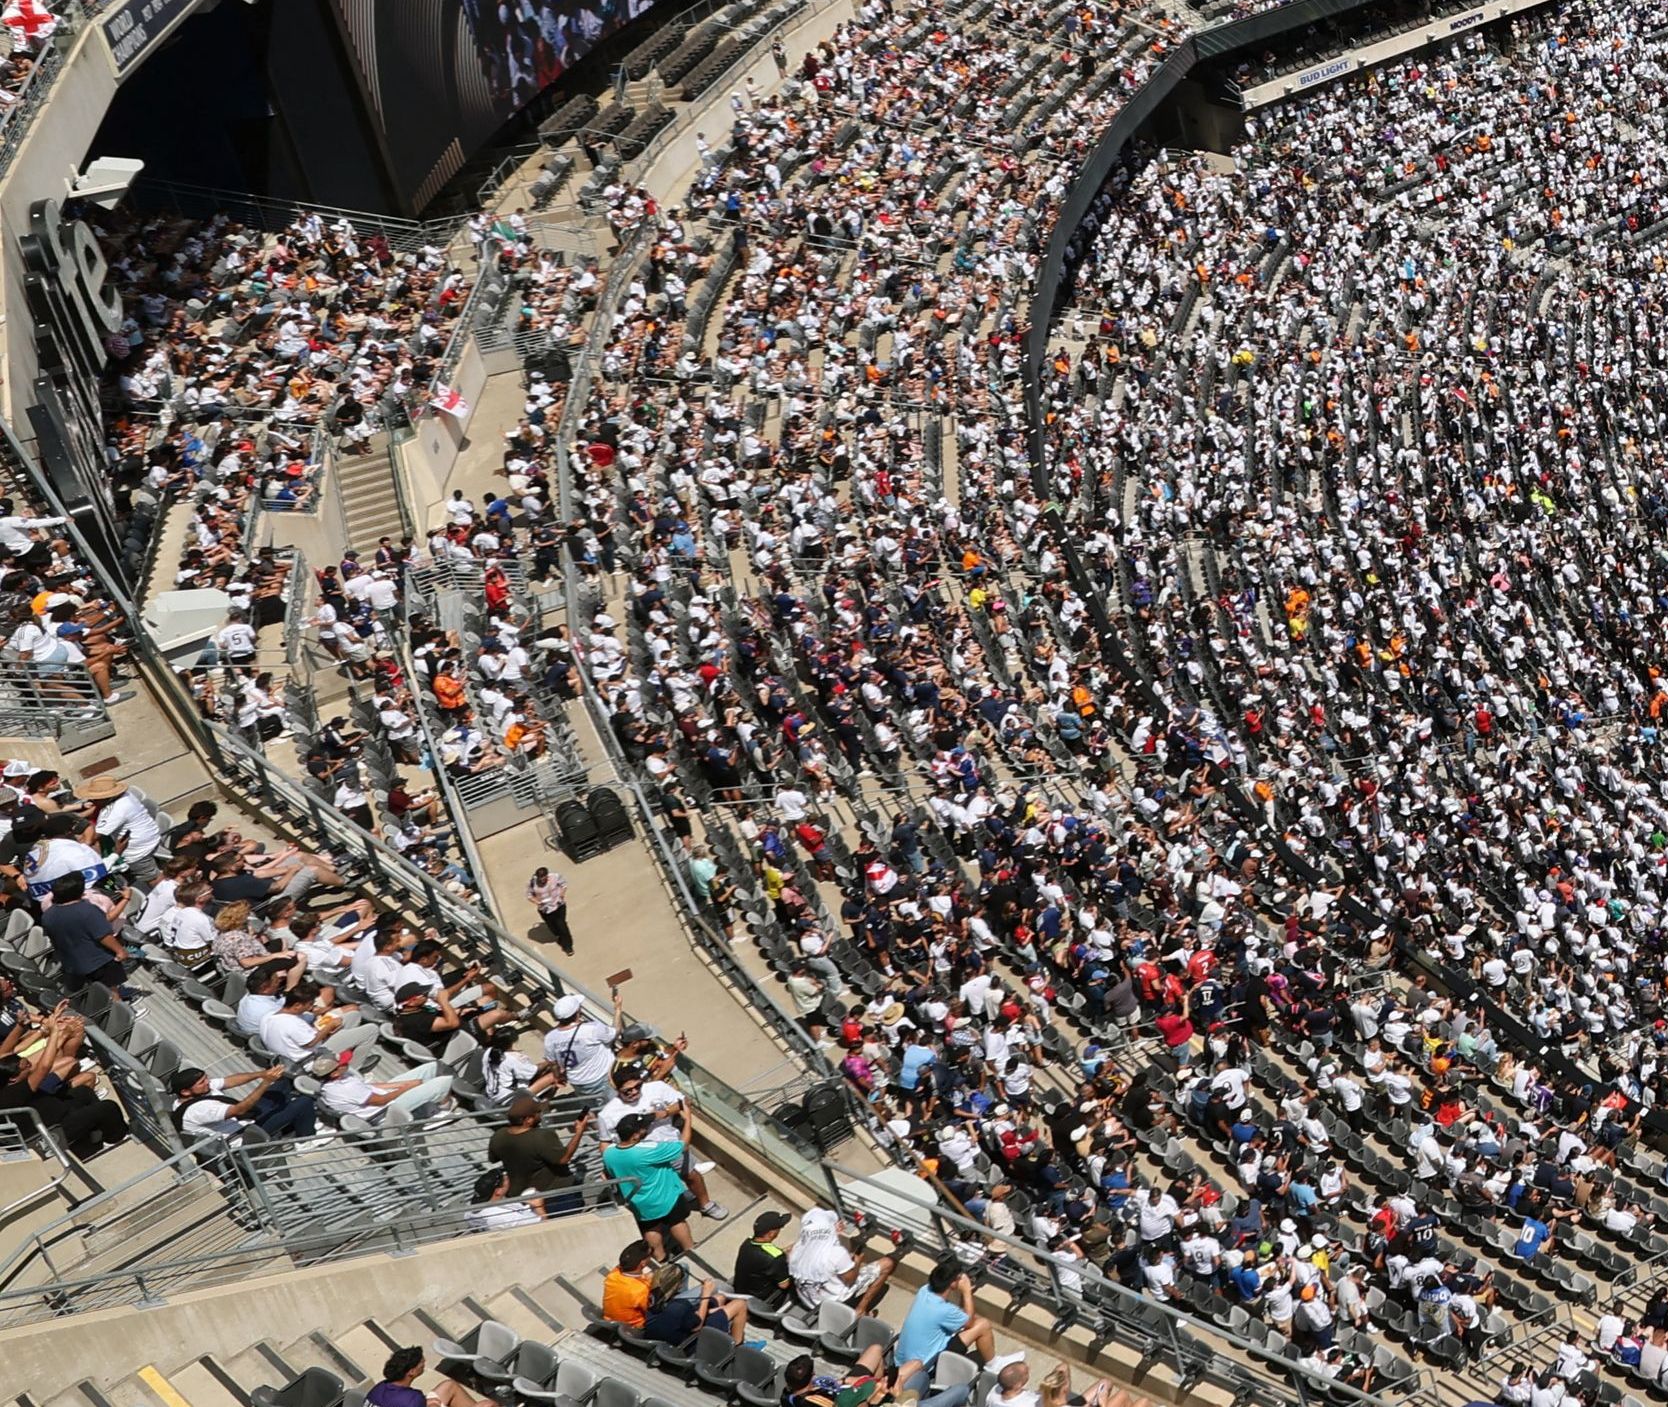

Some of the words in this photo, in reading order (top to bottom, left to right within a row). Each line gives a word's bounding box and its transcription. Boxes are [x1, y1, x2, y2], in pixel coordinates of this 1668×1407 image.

[1449, 12, 1485, 31] MOODY'S
[1300, 70, 1321, 85] BUD
[1320, 60, 1350, 78] LIGHT
[231, 632, 242, 646] 5
[1416, 1228, 1434, 1242] 10
[1520, 1224, 1536, 1243] 10
